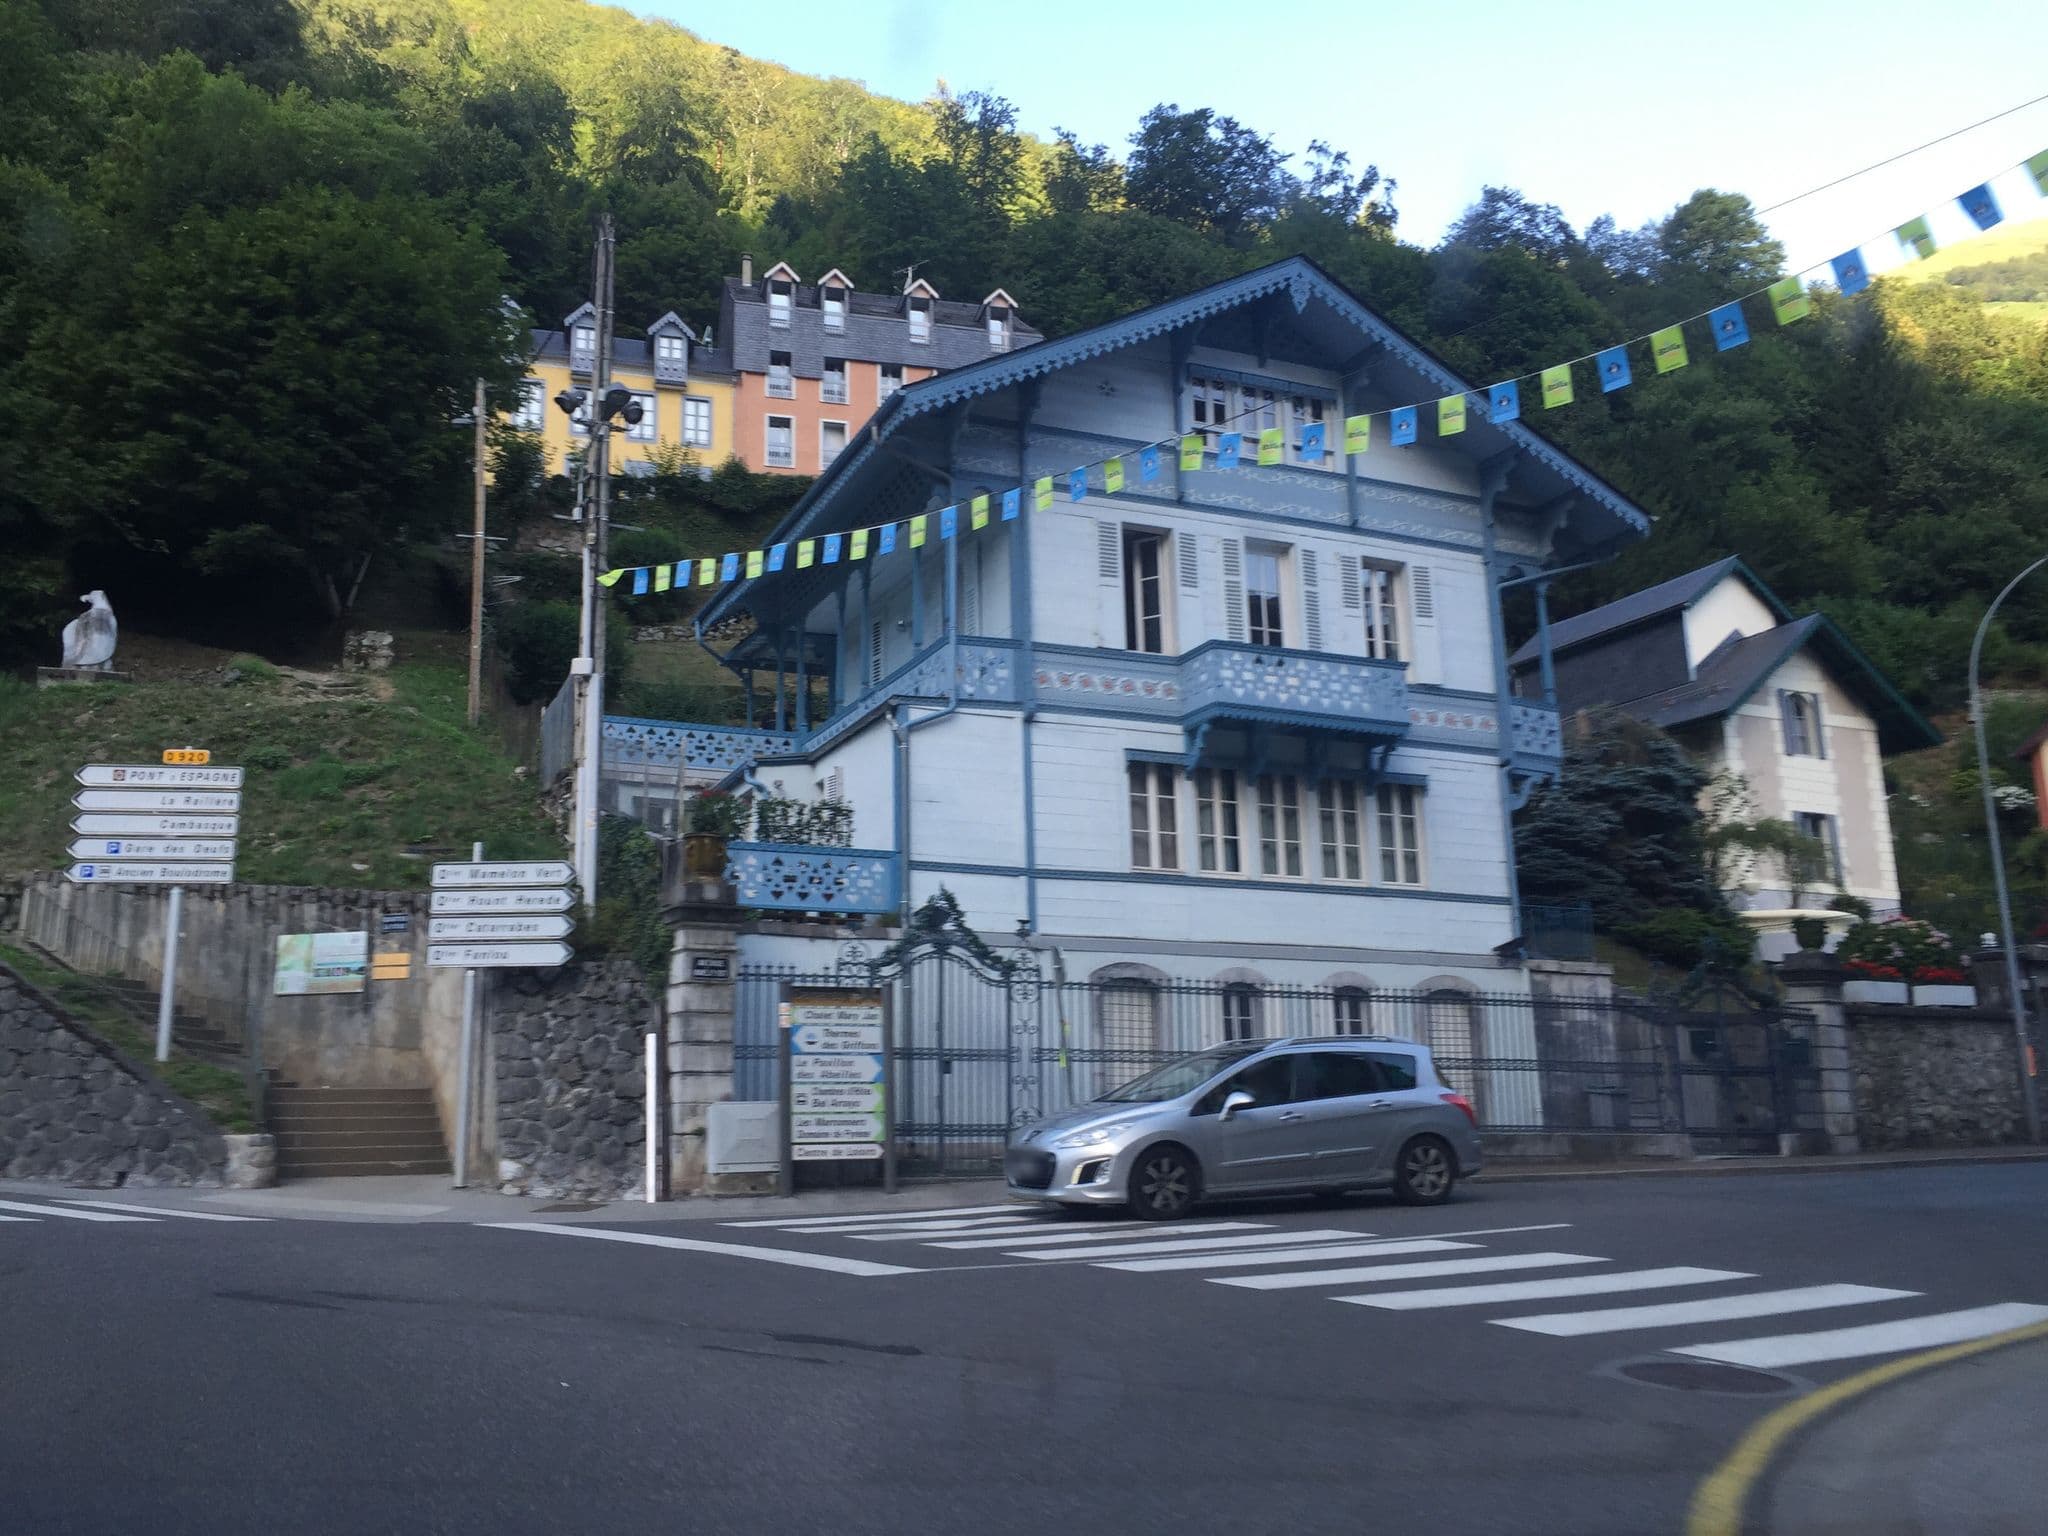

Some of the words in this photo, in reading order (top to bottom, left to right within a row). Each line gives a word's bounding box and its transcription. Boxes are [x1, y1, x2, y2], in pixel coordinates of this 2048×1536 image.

[166, 752, 173, 762] D
[178, 752, 205, 762] 920
[130, 771, 164, 781] PONT
